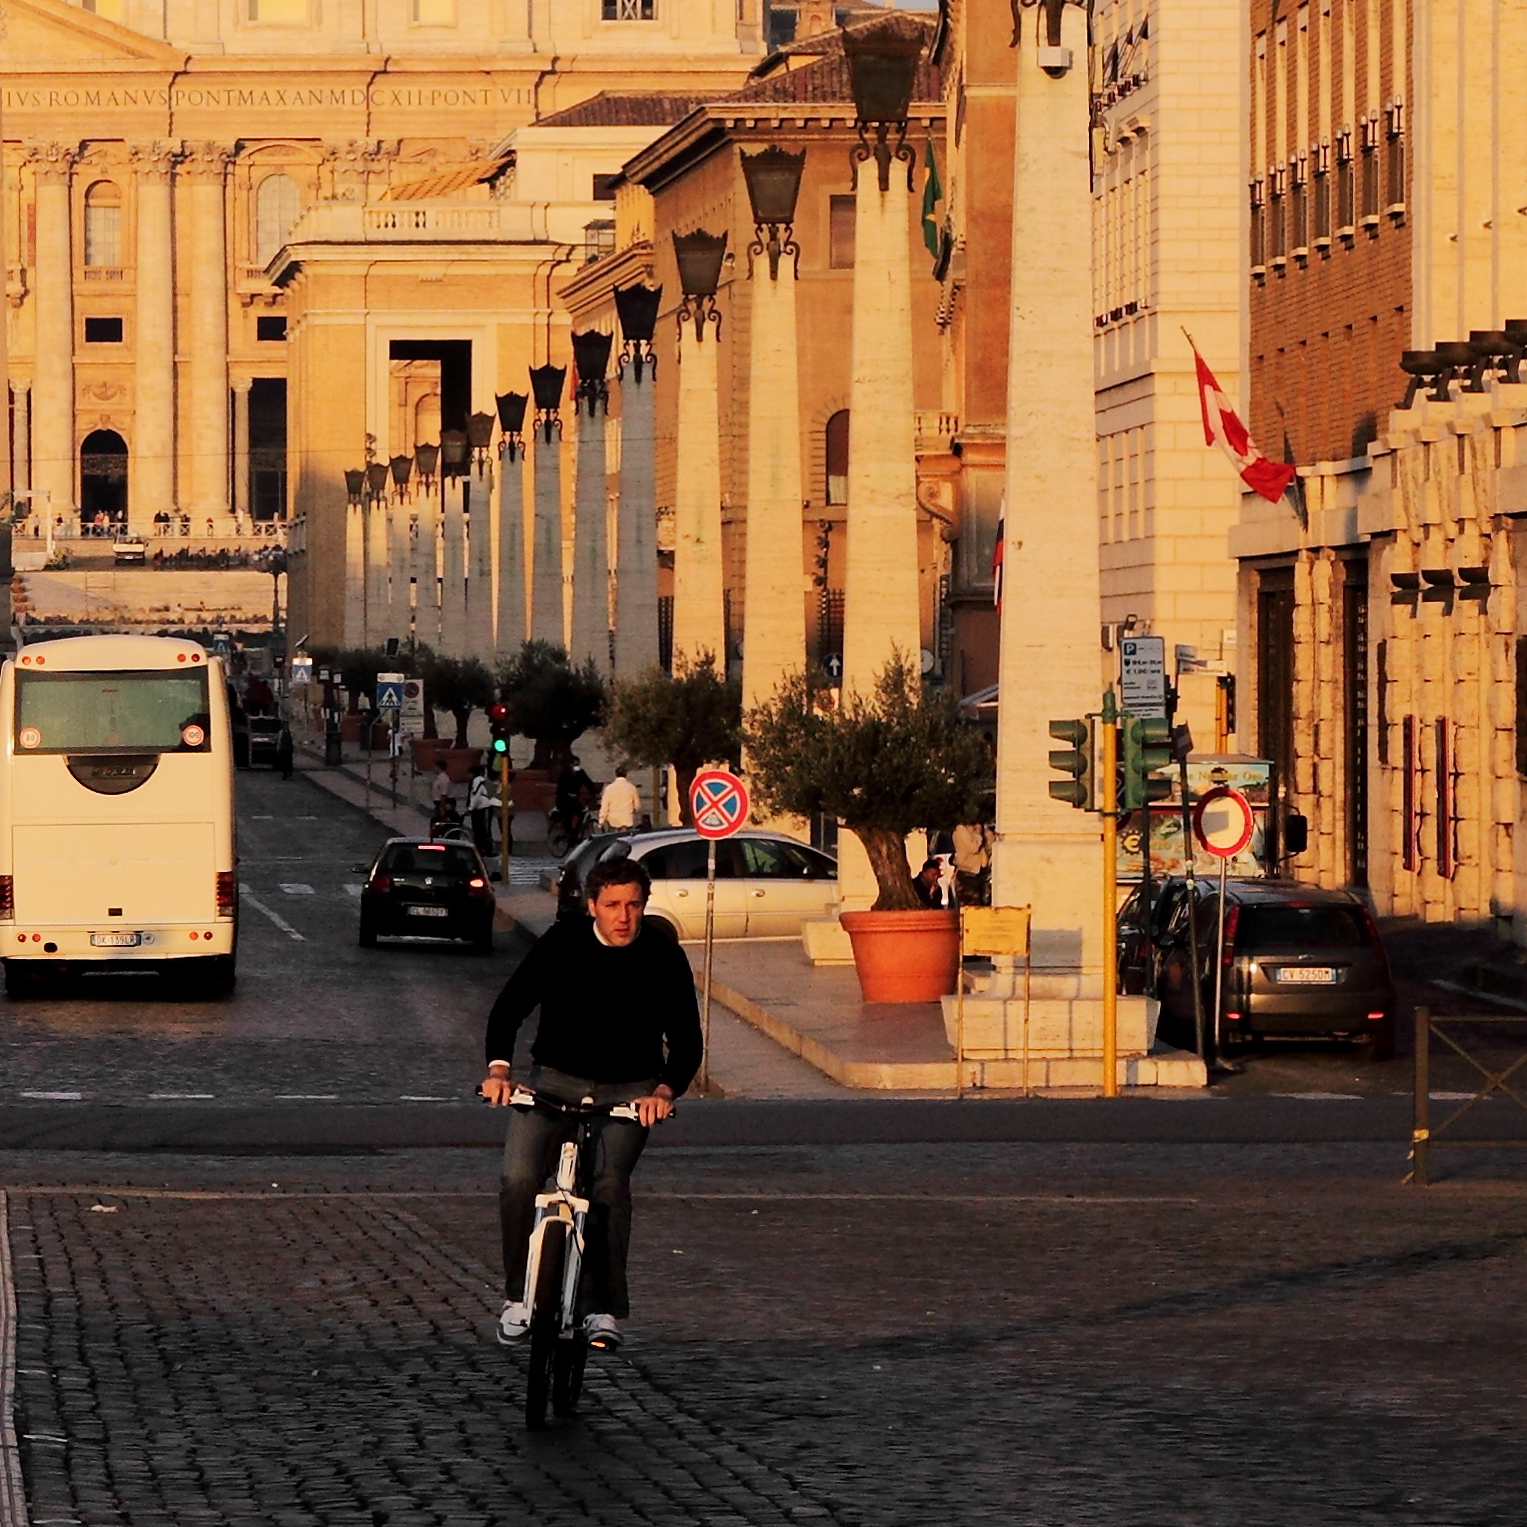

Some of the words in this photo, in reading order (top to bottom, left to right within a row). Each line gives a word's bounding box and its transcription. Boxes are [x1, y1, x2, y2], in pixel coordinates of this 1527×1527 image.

[49, 89, 168, 107] ROMANVS
[175, 89, 236, 107] PONT
[238, 89, 288, 106] MAX
[292, 89, 324, 106] AN
[330, 89, 423, 106] MDCXII
[431, 88, 493, 106] PONT
[499, 88, 532, 105] VII
